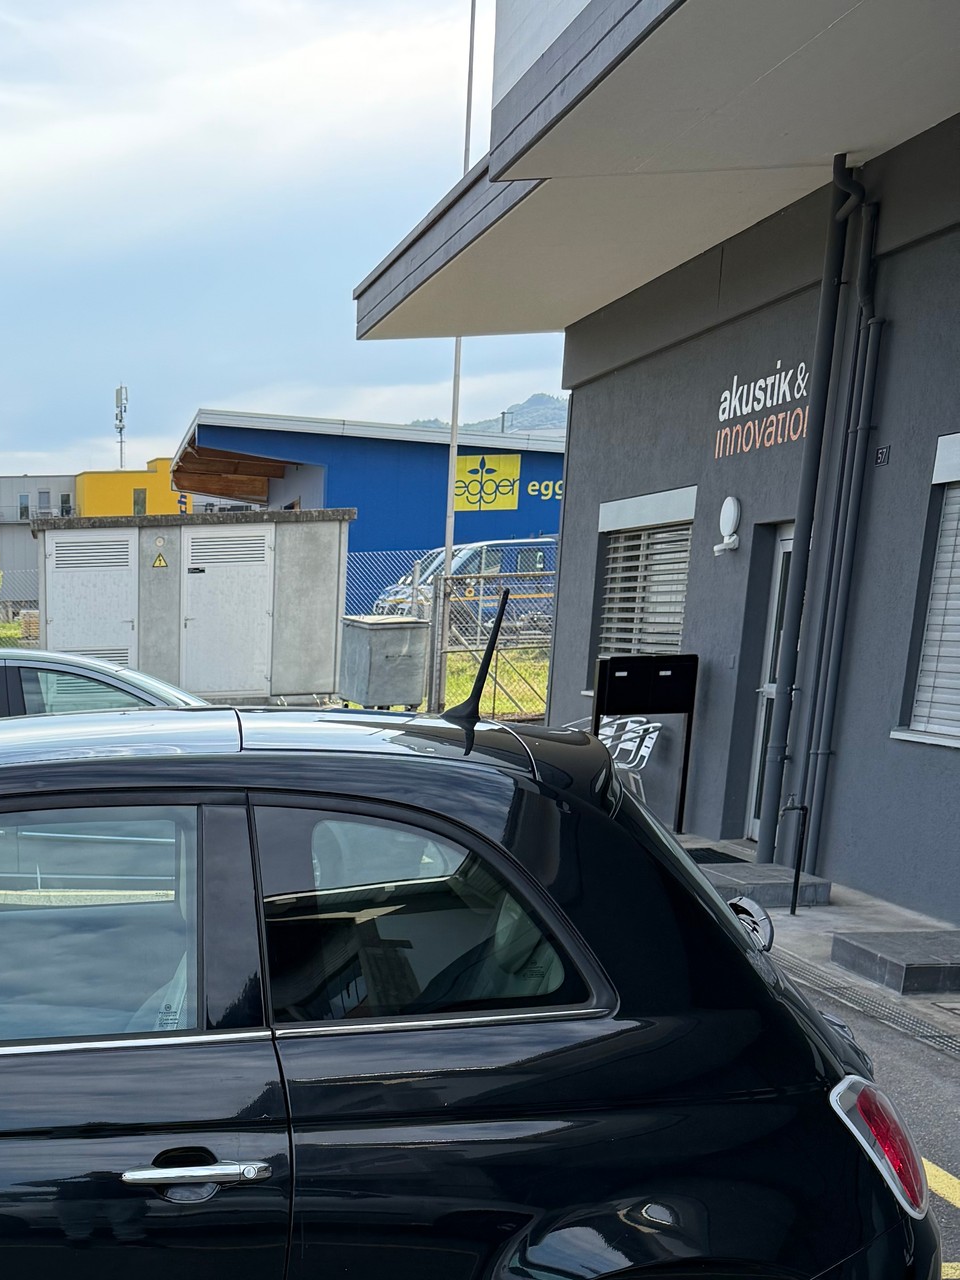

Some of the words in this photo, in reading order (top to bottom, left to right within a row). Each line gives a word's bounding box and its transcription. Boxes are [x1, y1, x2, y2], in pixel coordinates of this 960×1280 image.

[719, 360, 794, 422] akustik
[794, 362, 809, 400] &
[454, 478, 520, 505] egger
